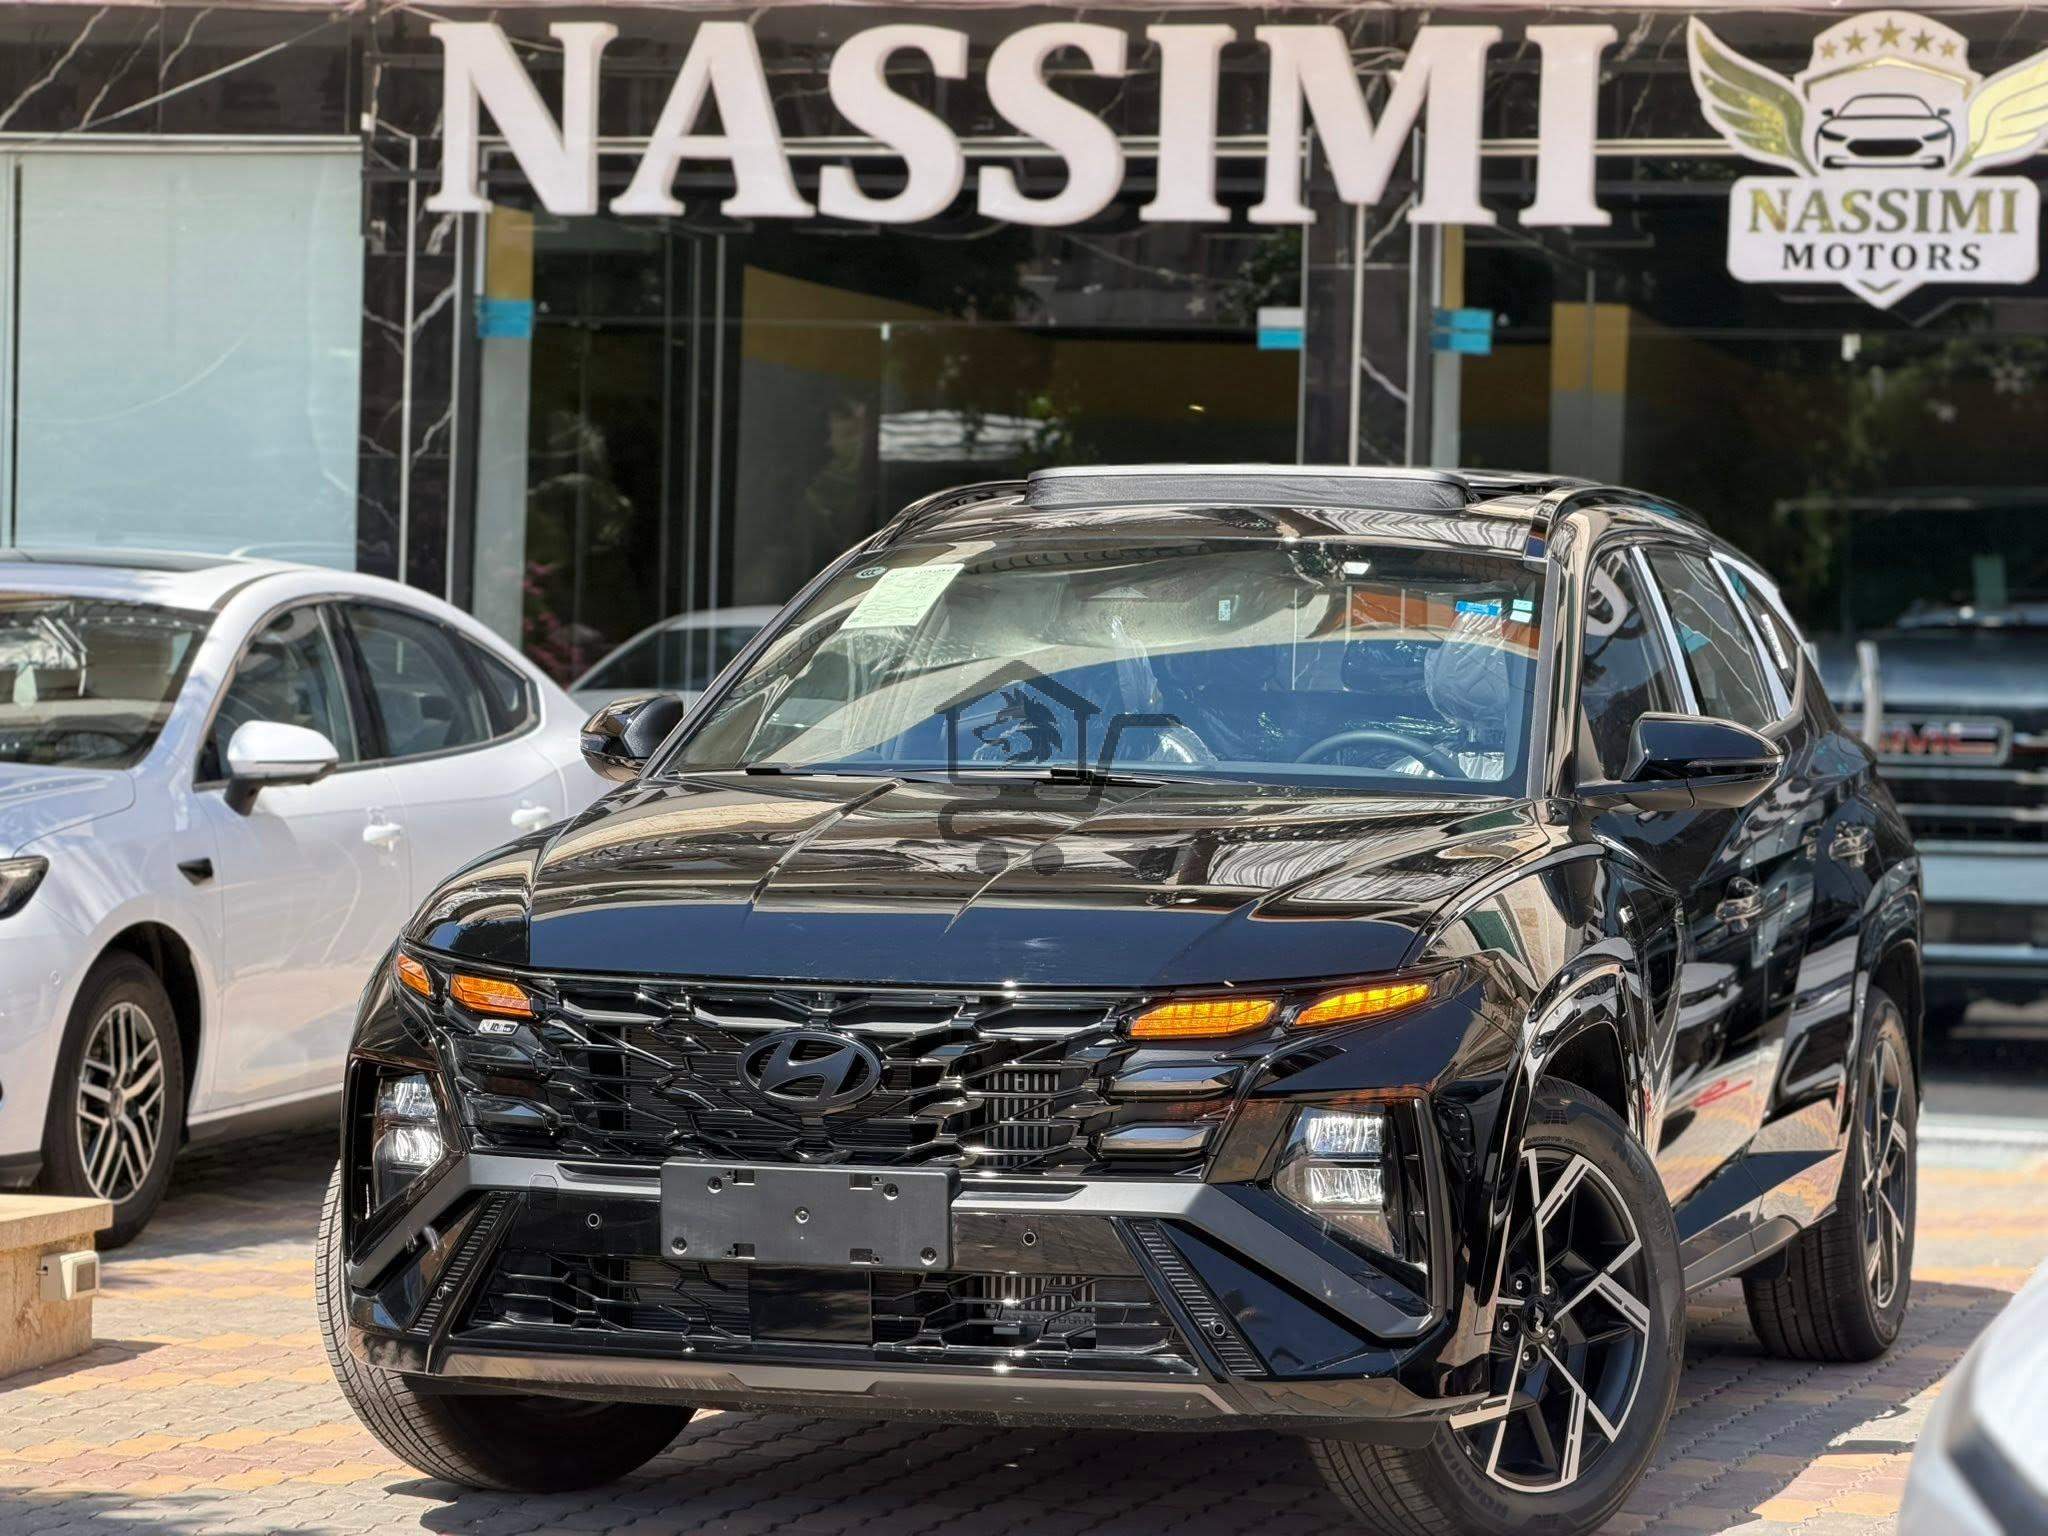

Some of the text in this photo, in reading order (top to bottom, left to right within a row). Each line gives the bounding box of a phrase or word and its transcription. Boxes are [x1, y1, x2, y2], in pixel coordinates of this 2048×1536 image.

[426, 21, 1619, 226] NASSIMI
[1747, 188, 2020, 234] NASSIMI
[1781, 243, 1981, 271] MOTORS
